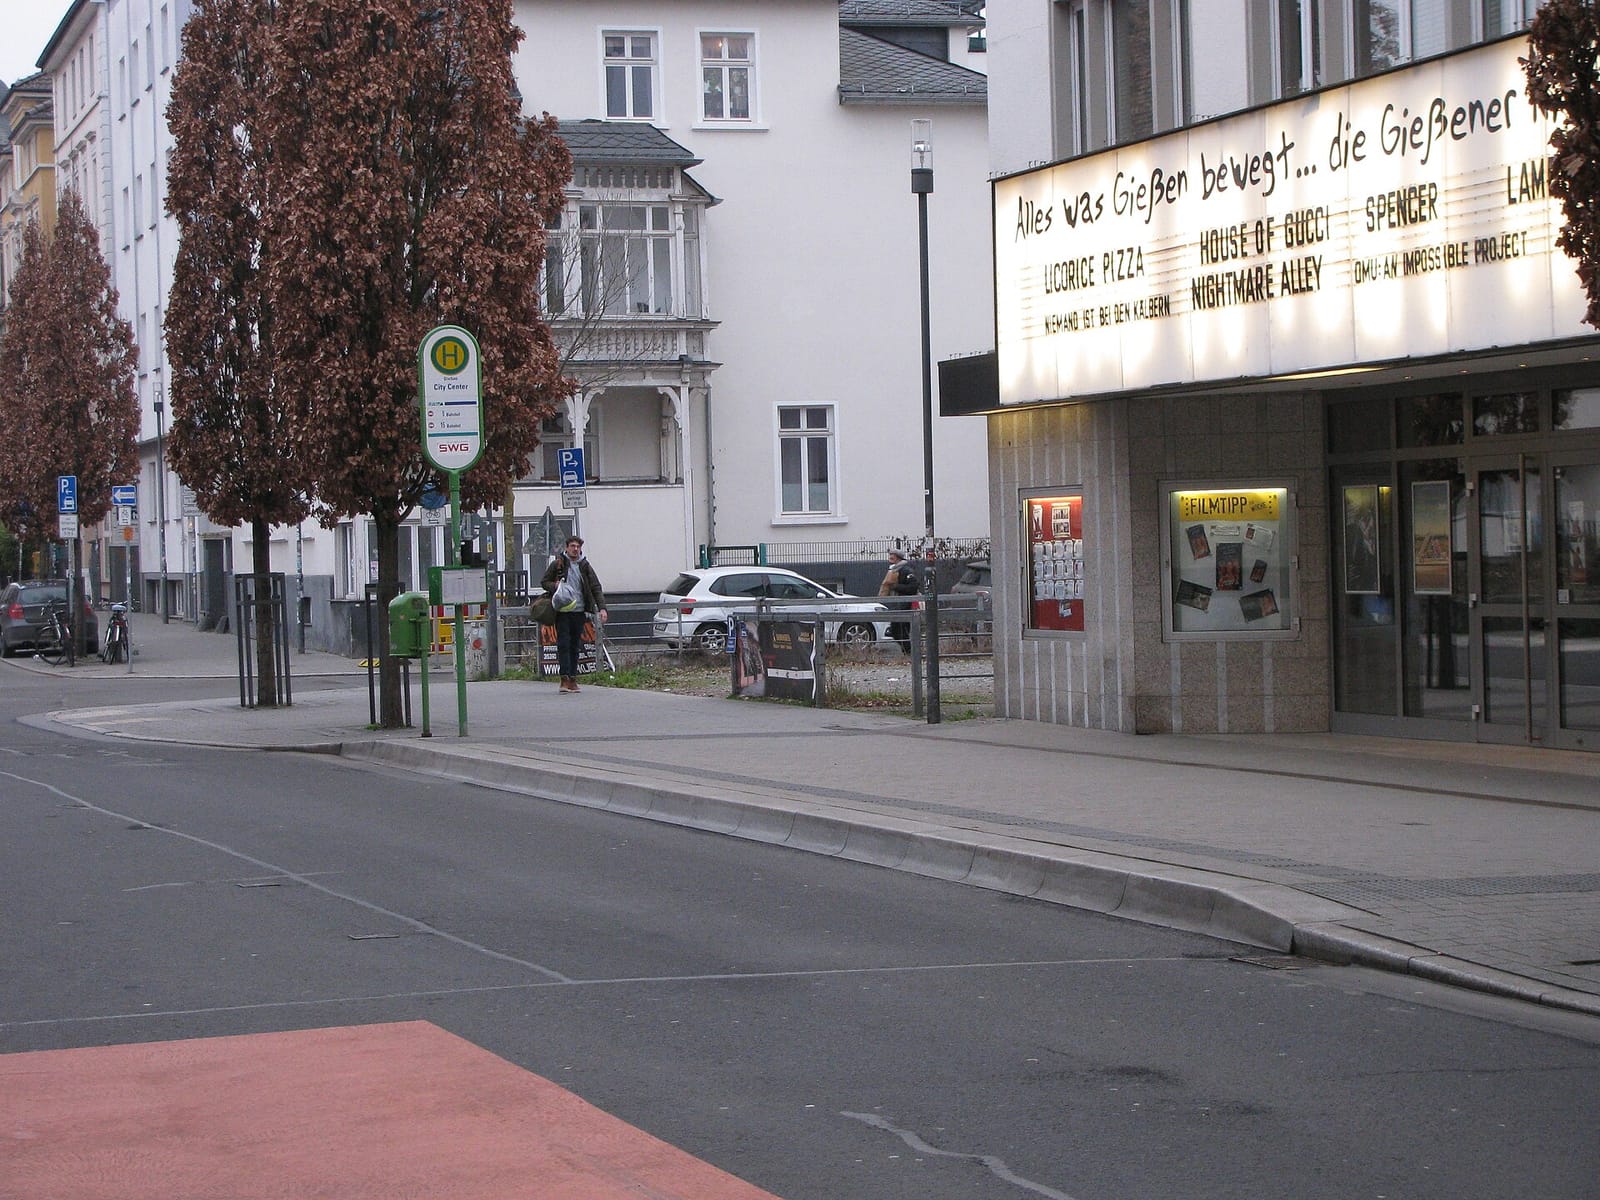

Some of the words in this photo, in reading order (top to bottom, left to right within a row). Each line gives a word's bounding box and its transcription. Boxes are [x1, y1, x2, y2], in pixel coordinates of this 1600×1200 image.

[1015, 196, 1053, 243] Alles
[1063, 191, 1104, 229] was
[1113, 167, 1188, 224] Gießen
[1329, 111, 1366, 172] die
[1380, 89, 1517, 165] Gießener
[1507, 158, 1551, 205] LAM
[1366, 182, 1438, 232] SPENCER
[1200, 223, 1248, 265] HOUSE
[1255, 216, 1275, 255] OF
[1284, 205, 1330, 249] GUCCI
[1045, 255, 1095, 294] LICORICE
[1103, 245, 1145, 284] PIZZA
[1383, 252, 1398, 280] AN
[1403, 241, 1469, 276] IMPOSSIBLE
[1474, 231, 1527, 264] PROJECT
[1191, 263, 1274, 310] NIGHTMARE
[1281, 254, 1323, 296] ALLEY
[1044, 311, 1079, 336] NIEMAND
[1083, 308, 1095, 329] IST
[1099, 304, 1111, 328] BEI
[1114, 302, 1131, 324] DEN
[442, 344, 458, 366] H
[433, 383, 446, 392] City
[439, 443, 468, 452] SWG
[562, 452, 573, 468] P
[61, 479, 69, 493] P
[1190, 496, 1247, 515] FILMTIPP
[728, 617, 734, 636] P
